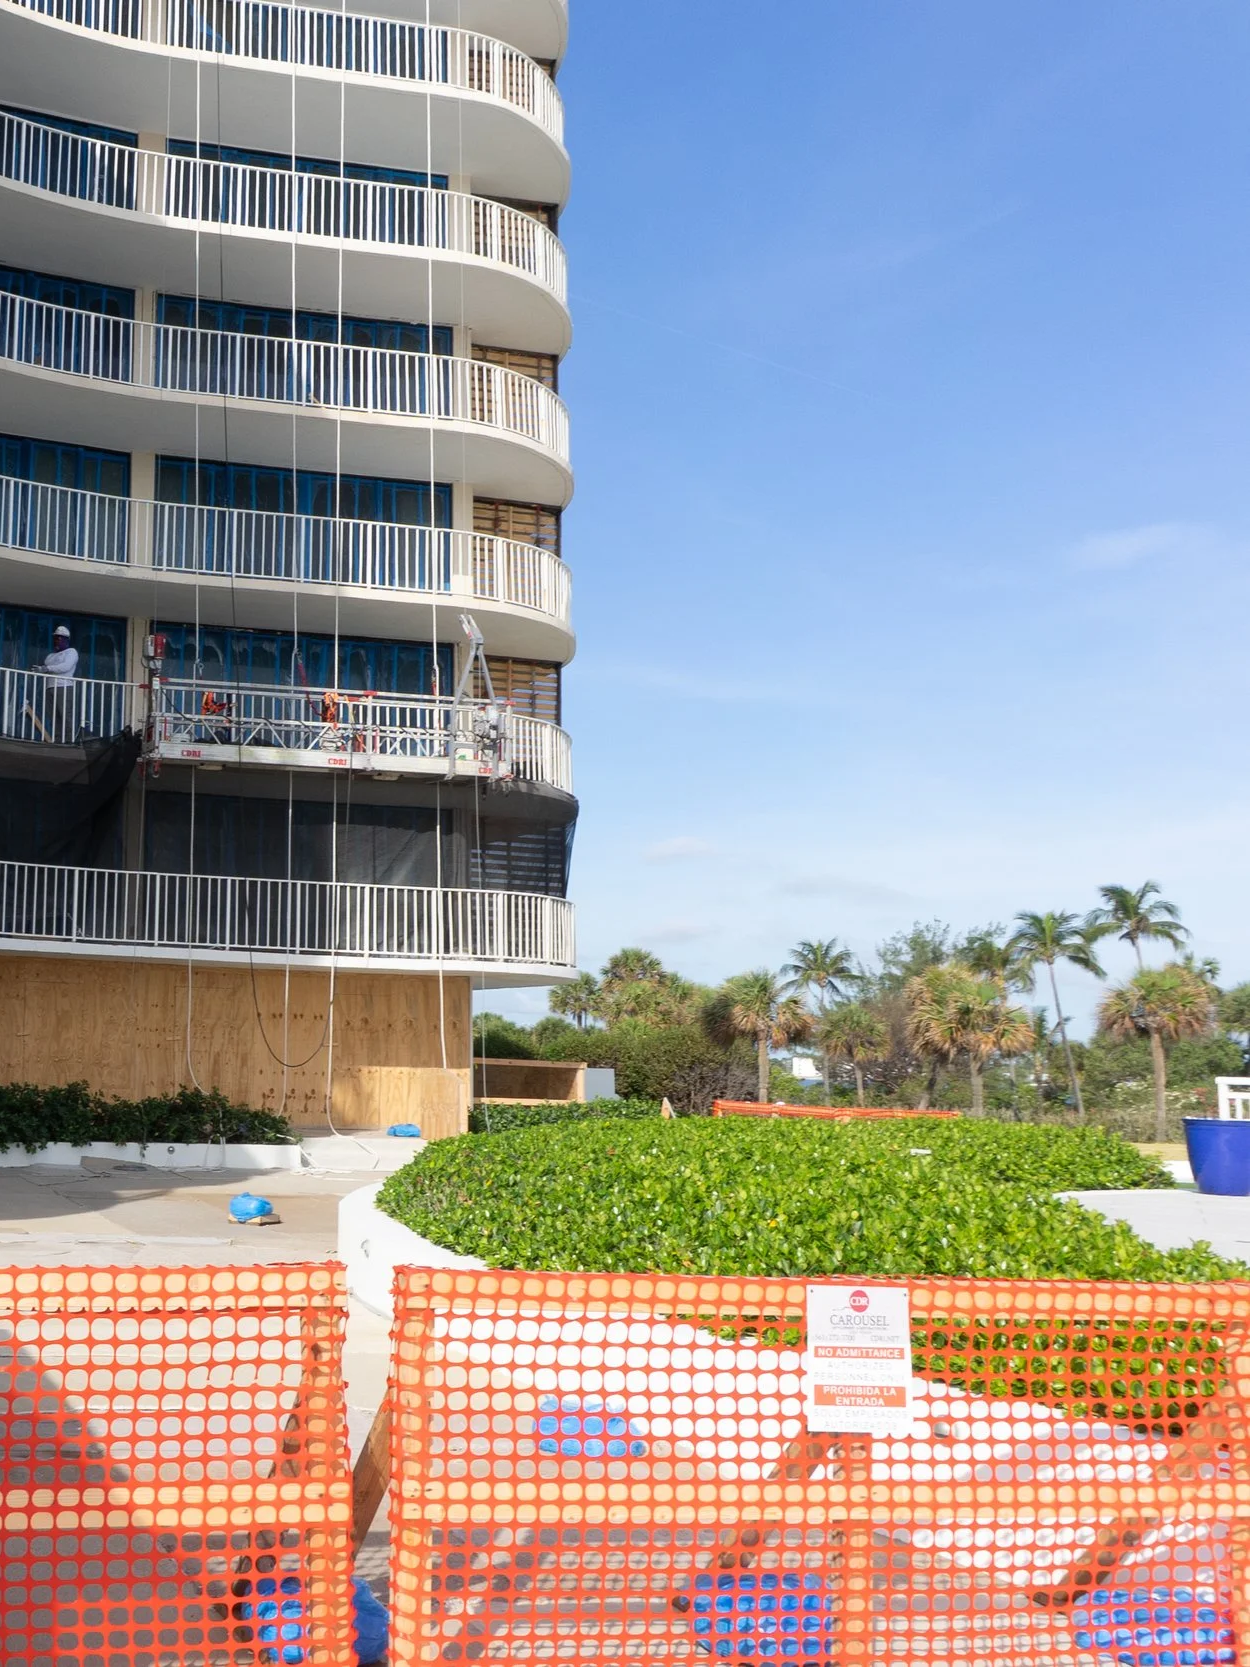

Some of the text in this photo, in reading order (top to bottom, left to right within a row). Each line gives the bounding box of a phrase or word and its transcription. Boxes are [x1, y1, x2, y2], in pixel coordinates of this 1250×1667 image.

[849, 1296, 869, 1306] CDR
[830, 1314, 890, 1327] CAROUSEL
[818, 1348, 901, 1358] NO ADMITTANCE
[823, 1386, 896, 1396] PROHIBIDA LA
[836, 1397, 885, 1406] ENTRADA
